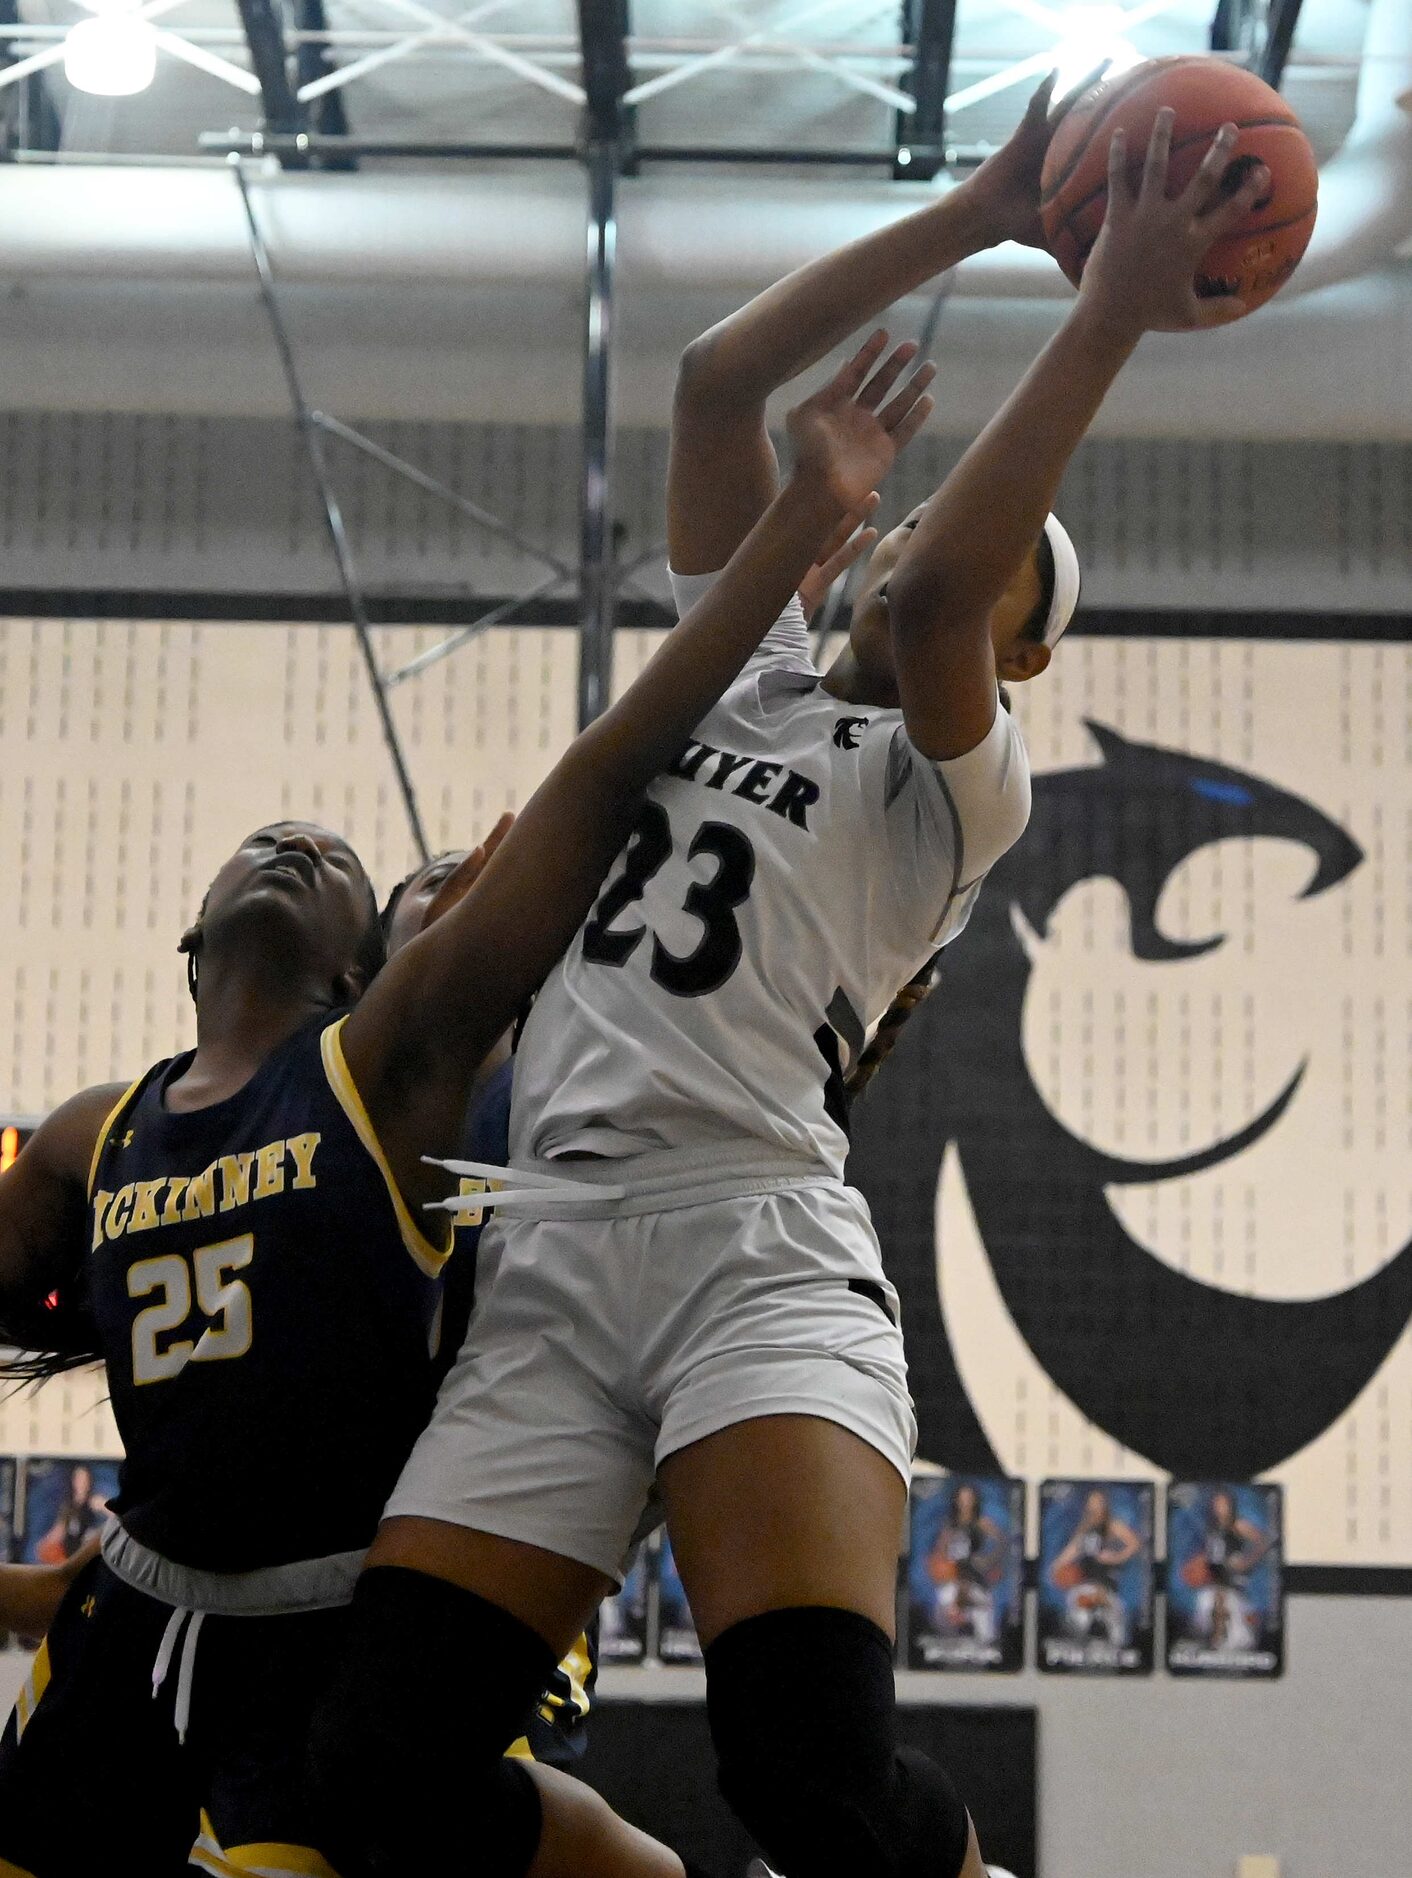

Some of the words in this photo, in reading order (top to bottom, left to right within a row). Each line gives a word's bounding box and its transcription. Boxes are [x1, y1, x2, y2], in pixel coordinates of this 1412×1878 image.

[668, 737, 820, 833] UYER
[582, 801, 756, 998] 23
[126, 1232, 254, 1387] 25
